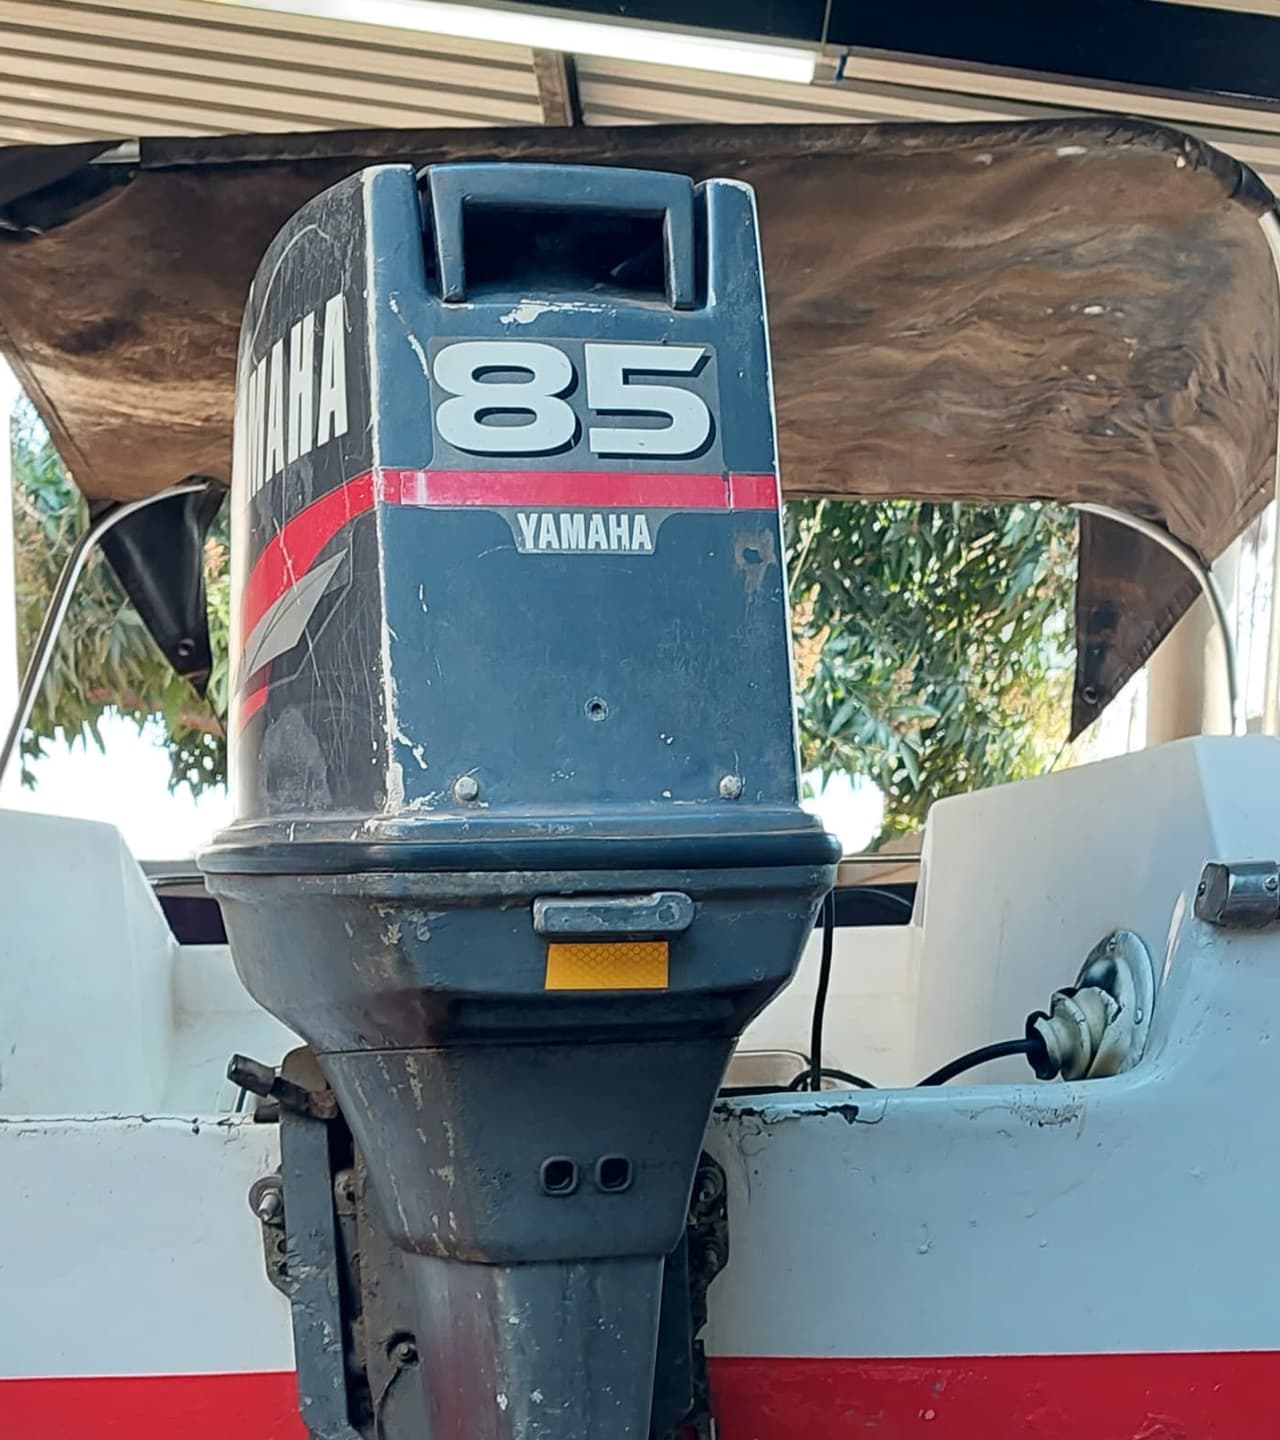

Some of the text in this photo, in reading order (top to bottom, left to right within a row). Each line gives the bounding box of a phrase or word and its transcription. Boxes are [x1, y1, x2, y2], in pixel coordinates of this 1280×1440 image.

[246, 292, 348, 504] MAHA
[433, 341, 715, 460] 85
[516, 512, 652, 551] YAMAHA
